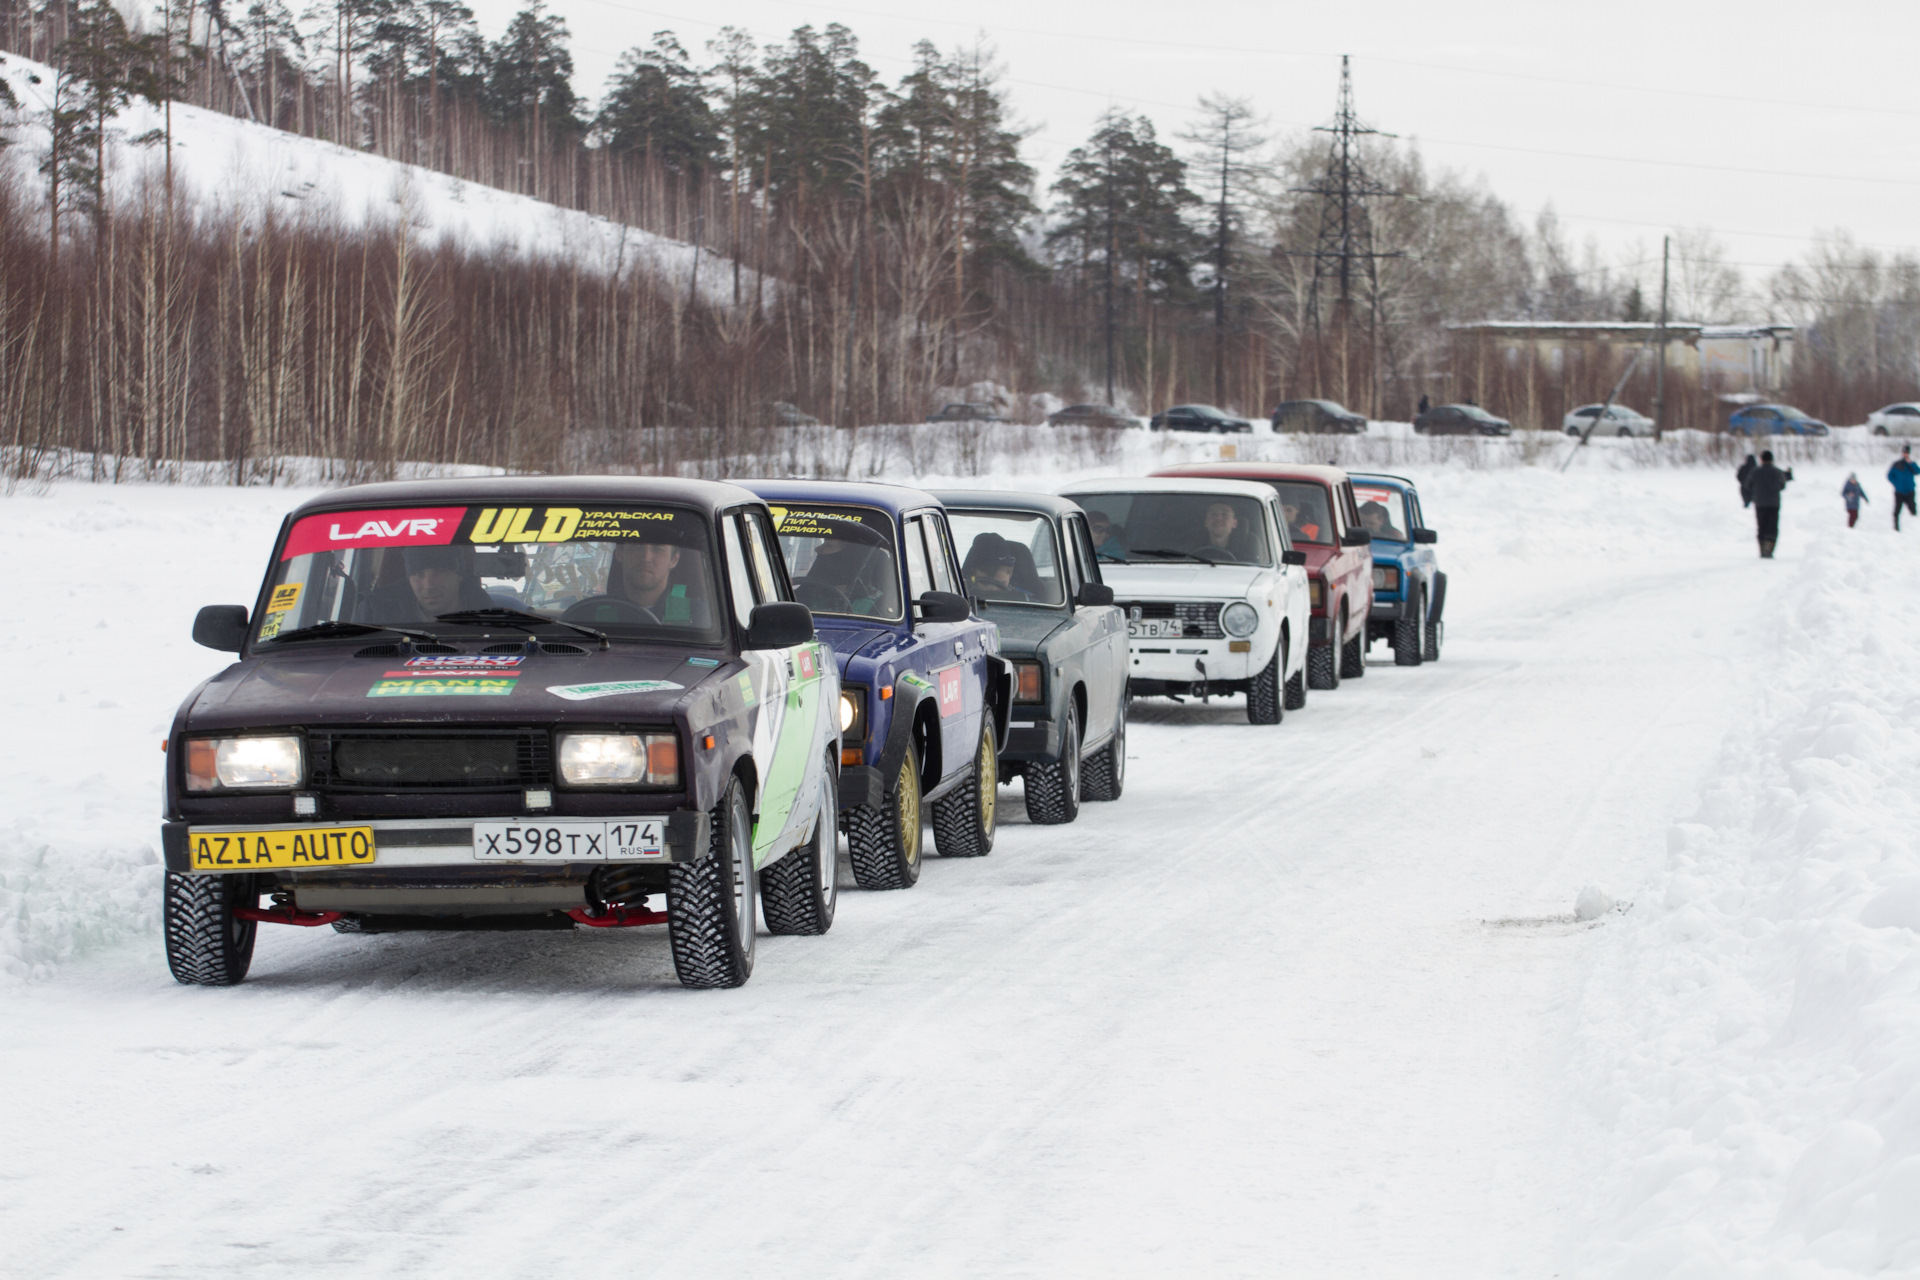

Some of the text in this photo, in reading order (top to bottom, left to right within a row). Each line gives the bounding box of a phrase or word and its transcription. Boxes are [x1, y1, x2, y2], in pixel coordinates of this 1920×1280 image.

[584, 511, 674, 521] УРАЛЬСКАЯ
[789, 510, 862, 523] УРАЛЬСКАЯ
[469, 508, 583, 543] ULD
[579, 520, 620, 528] ЛИГА
[784, 518, 817, 526] ЛИГА
[329, 518, 439, 540] LAVR
[574, 529, 640, 538] ДРИФТА
[779, 526, 833, 534] ДРИФТА
[1162, 620, 1177, 632] 74
[382, 680, 508, 688] MANN
[377, 686, 503, 695] FILTER
[611, 824, 654, 846] 174
[198, 831, 369, 864] AZIA-AUTO
[621, 847, 643, 855] RUS
